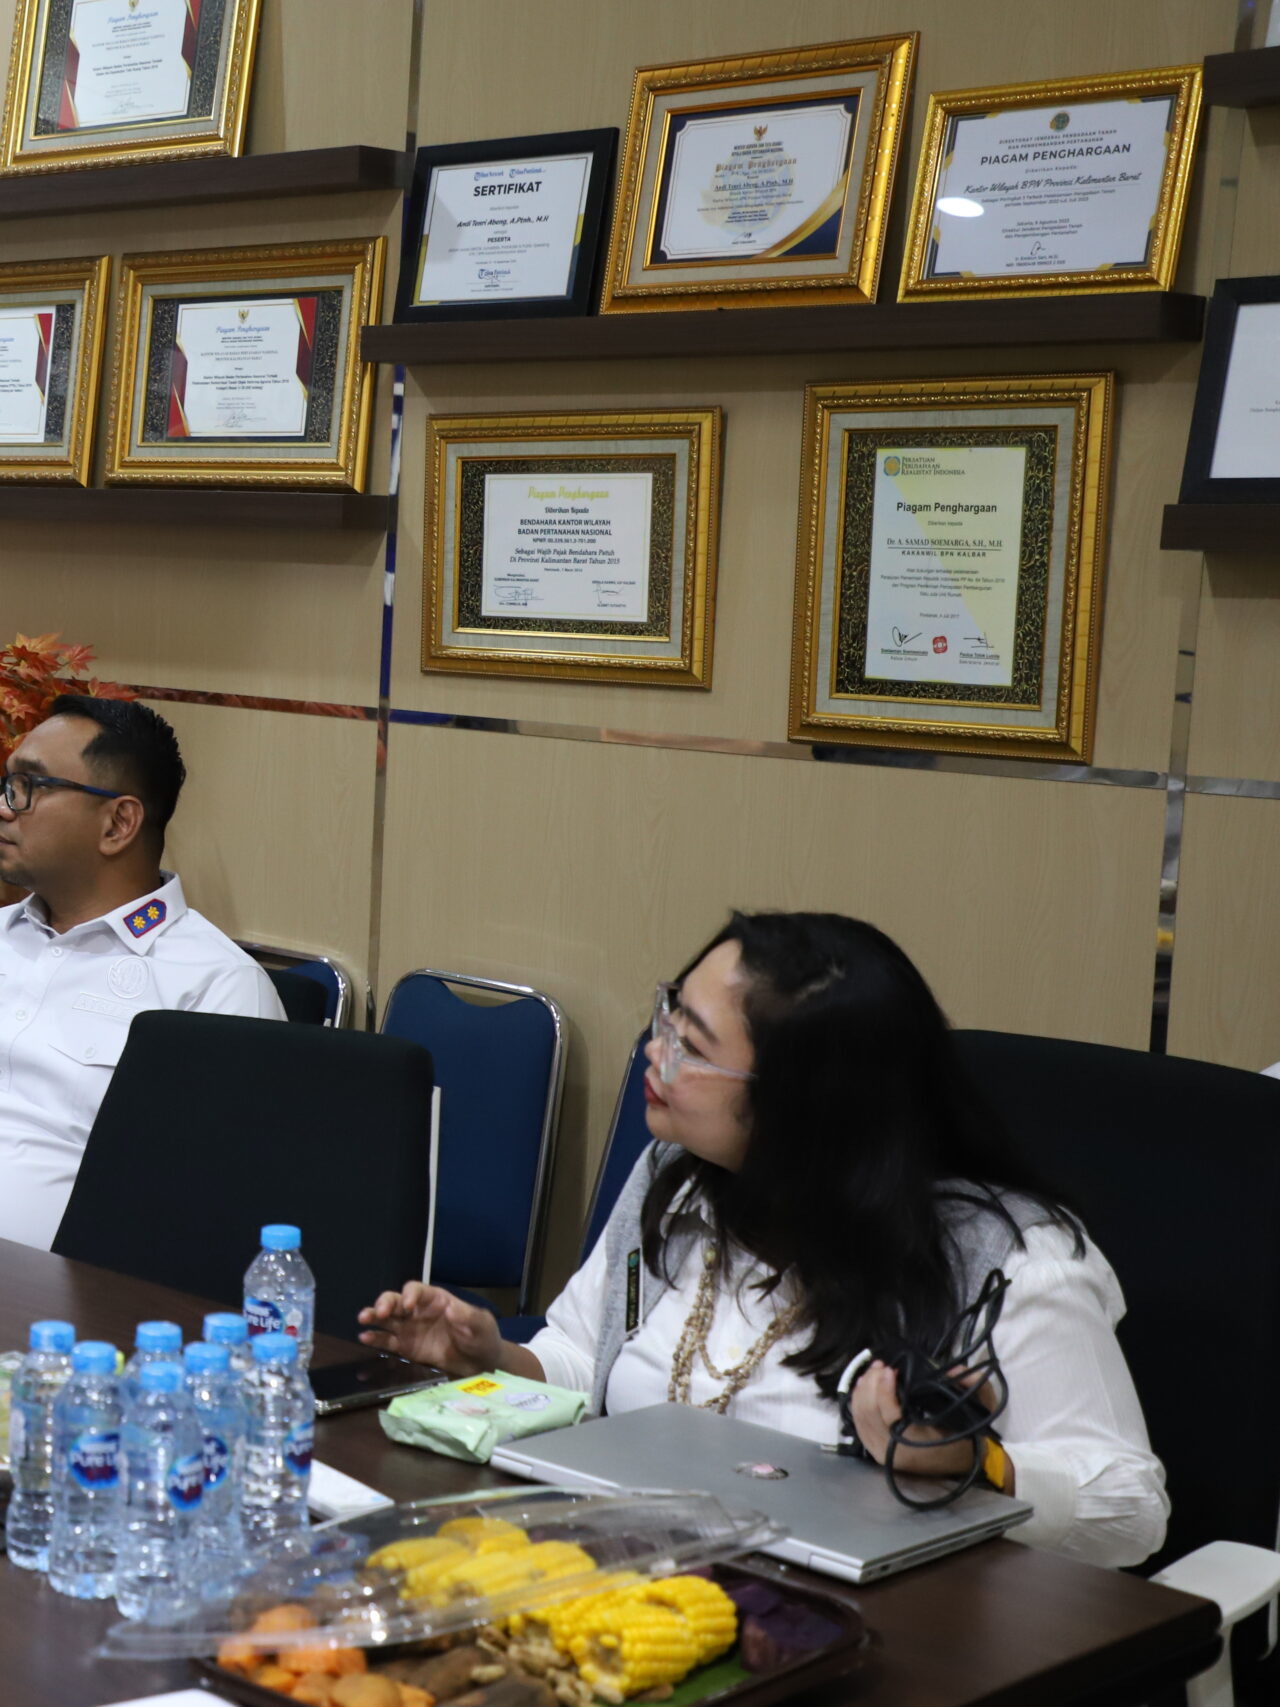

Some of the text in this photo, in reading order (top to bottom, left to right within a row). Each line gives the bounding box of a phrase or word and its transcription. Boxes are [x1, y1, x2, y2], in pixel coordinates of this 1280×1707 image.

[980, 143, 1132, 166] PIAGAM PENGHARGAAN
[473, 181, 542, 197] SERTIFIKAT
[896, 502, 998, 515] Piagam Penghargaan
[583, 519, 611, 527] WILAYAH
[517, 528, 539, 536] BADAN
[539, 528, 580, 536] PERTANAHAN
[905, 538, 929, 546] SAMAD
